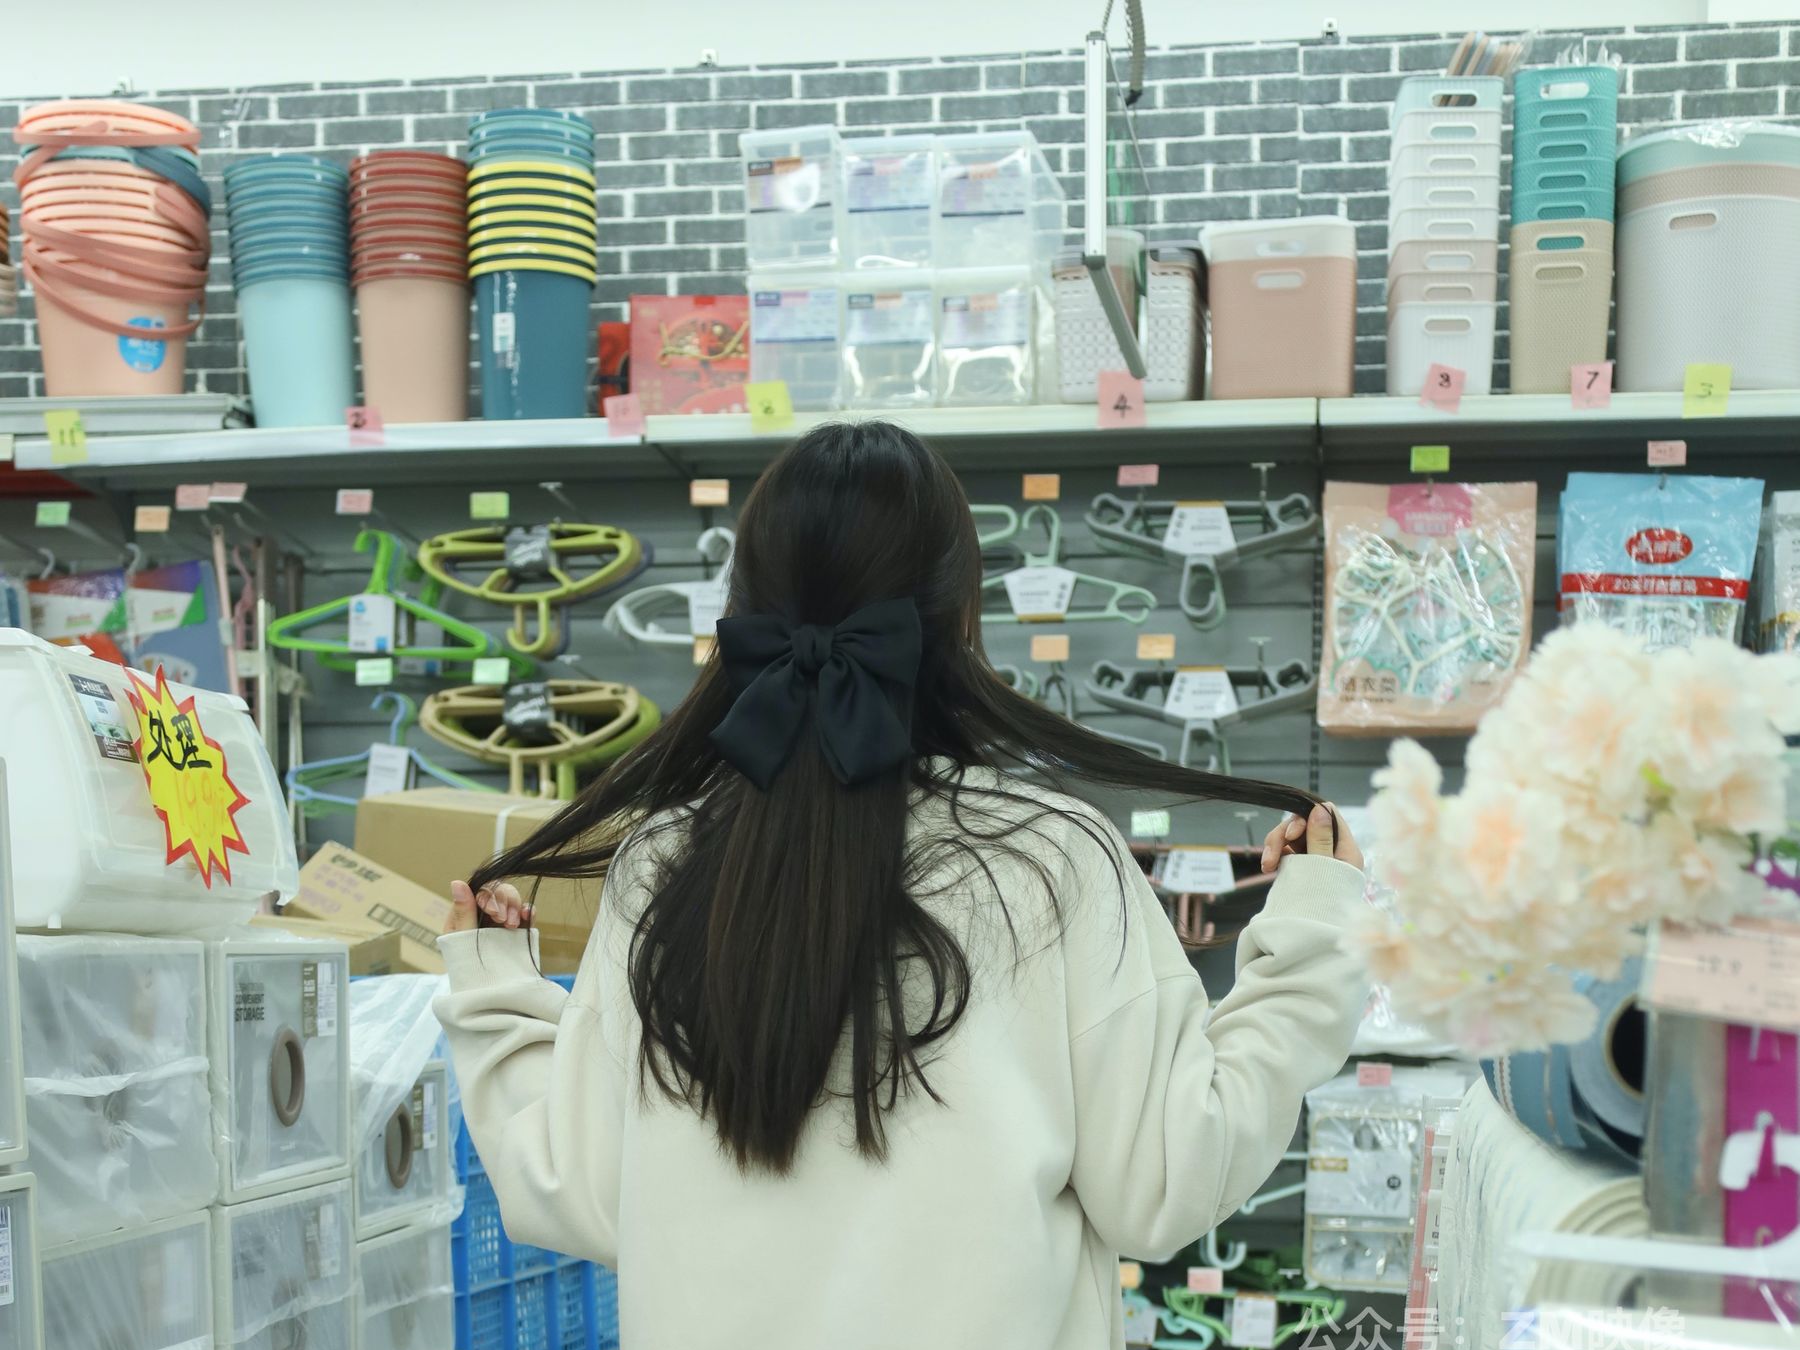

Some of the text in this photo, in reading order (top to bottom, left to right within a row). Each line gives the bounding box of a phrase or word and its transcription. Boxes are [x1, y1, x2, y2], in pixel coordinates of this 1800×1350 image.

[1586, 371, 1600, 390] 7
[1112, 394, 1132, 419] 4
[147, 710, 213, 771] 处理
[234, 1006, 265, 1022] STORAGE
